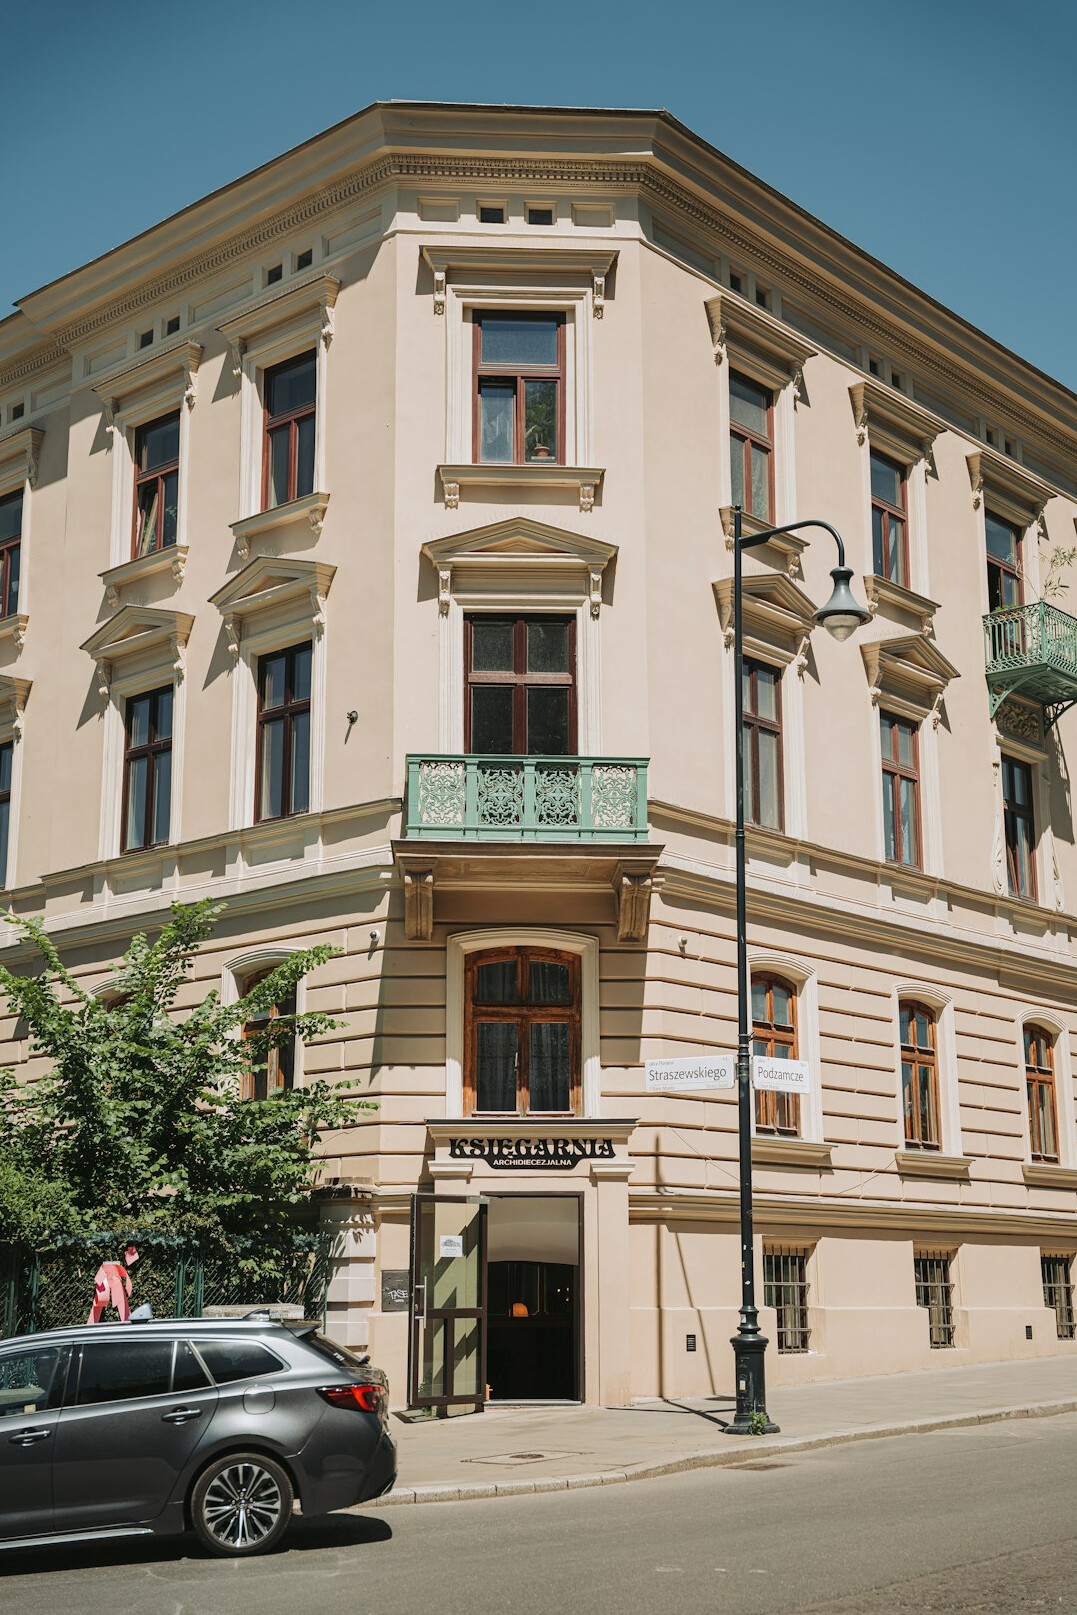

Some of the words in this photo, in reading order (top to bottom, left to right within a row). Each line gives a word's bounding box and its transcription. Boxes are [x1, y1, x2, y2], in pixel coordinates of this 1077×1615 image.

[648, 1066, 727, 1081] Straszewskiego
[757, 1066, 804, 1082] Podzamcze
[449, 1138, 616, 1158] KSIĘGARNIA
